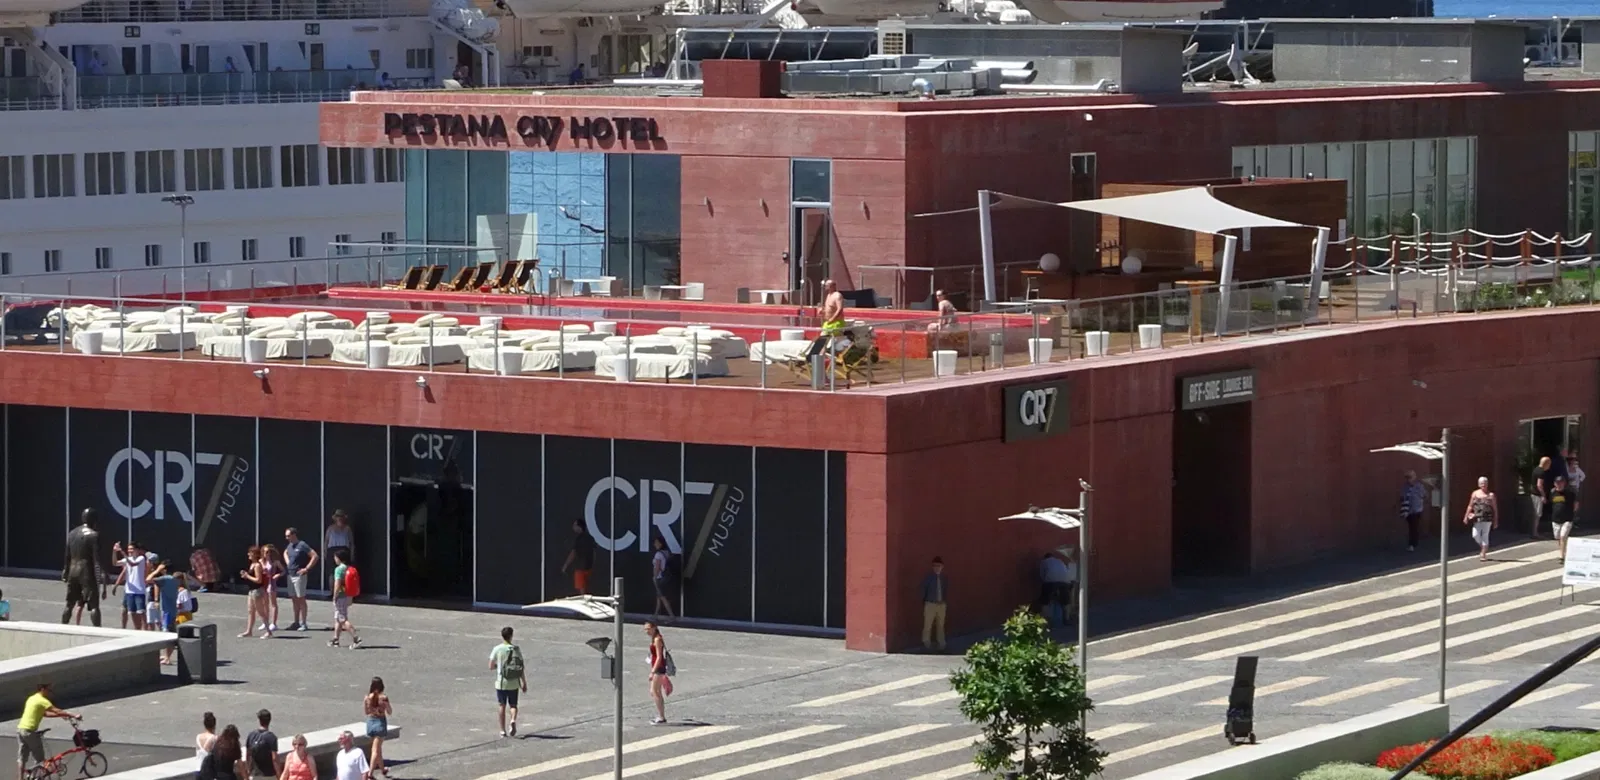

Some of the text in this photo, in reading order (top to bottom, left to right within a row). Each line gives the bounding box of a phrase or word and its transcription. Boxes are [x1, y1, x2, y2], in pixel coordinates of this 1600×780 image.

[383, 112, 665, 149] PESTANA CR7 HOTEL
[1020, 387, 1058, 434] CR7
[410, 433, 457, 469] CR7
[105, 447, 235, 545] CR7
[216, 457, 249, 524] MUSEU
[708, 486, 745, 556] MUSEU
[584, 476, 729, 579] CR7
